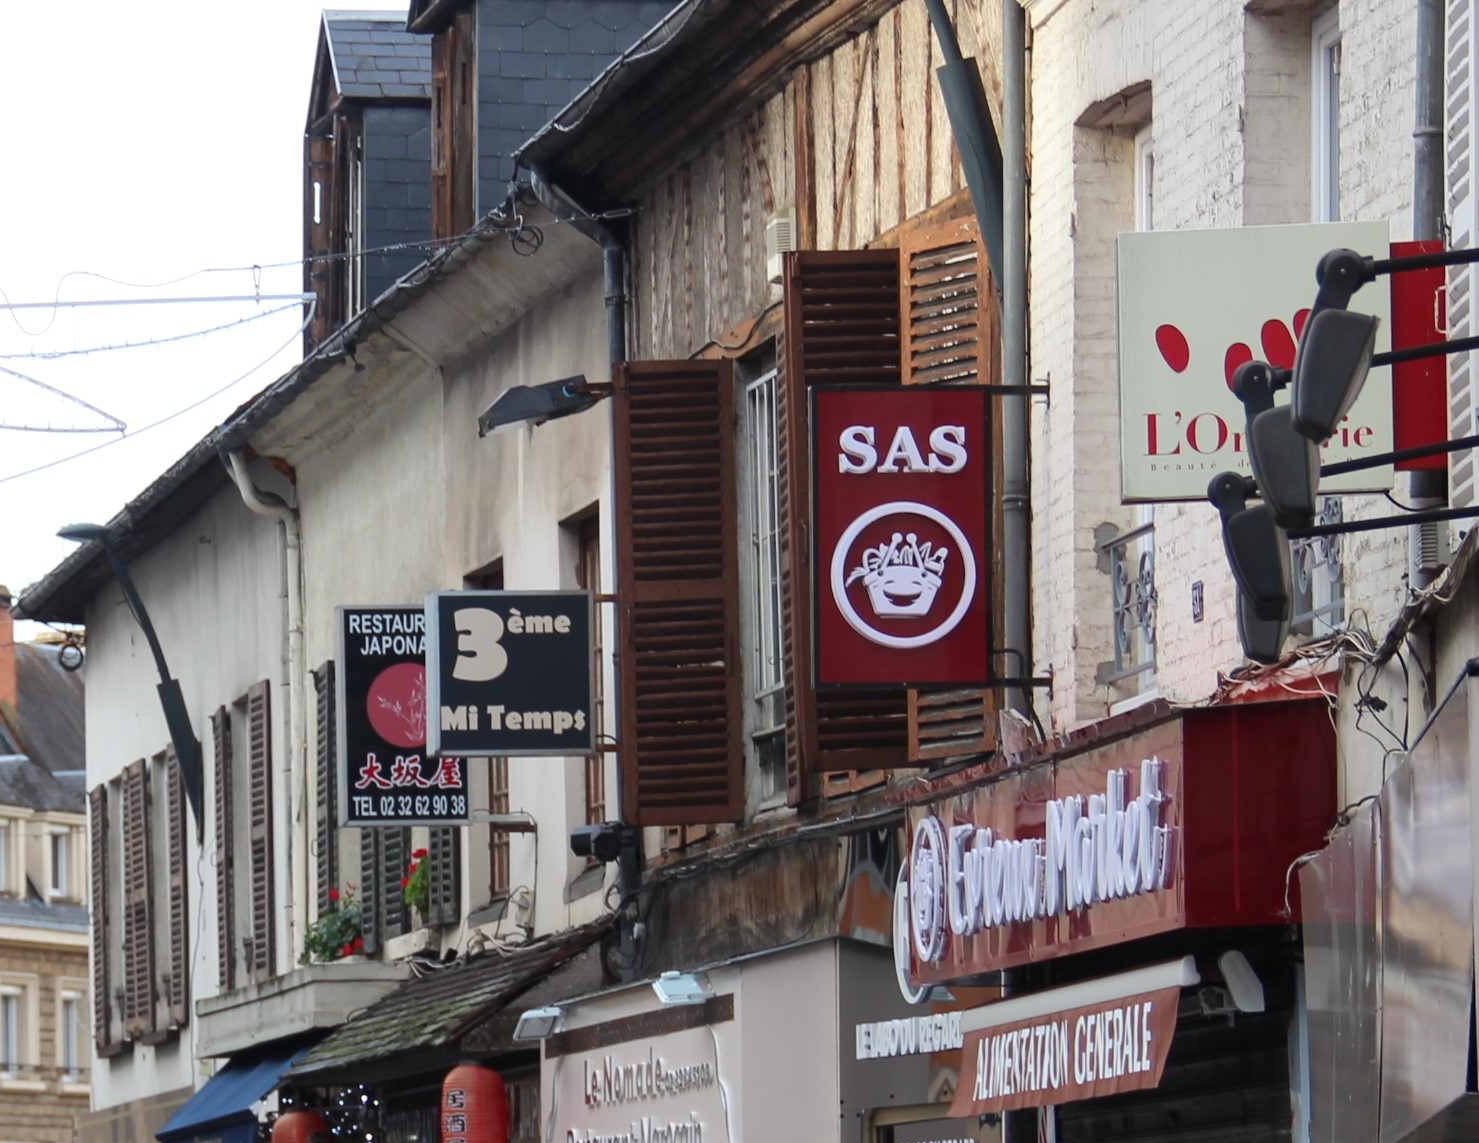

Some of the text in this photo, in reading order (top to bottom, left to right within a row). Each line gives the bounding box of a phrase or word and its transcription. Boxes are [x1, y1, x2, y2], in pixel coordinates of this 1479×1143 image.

[838, 425, 968, 474] SAS
[1150, 460, 1217, 472] Beauté
[348, 614, 426, 634] RESTAUR
[360, 635, 427, 656] JAPONA
[441, 705, 586, 735] Mi Temps
[352, 795, 466, 816] TEL 02 32 62 90 38
[972, 1001, 1152, 1102] ALIMENTATION GENERALE
[584, 1059, 600, 1106] Le
[603, 1046, 663, 1103] Nomade
